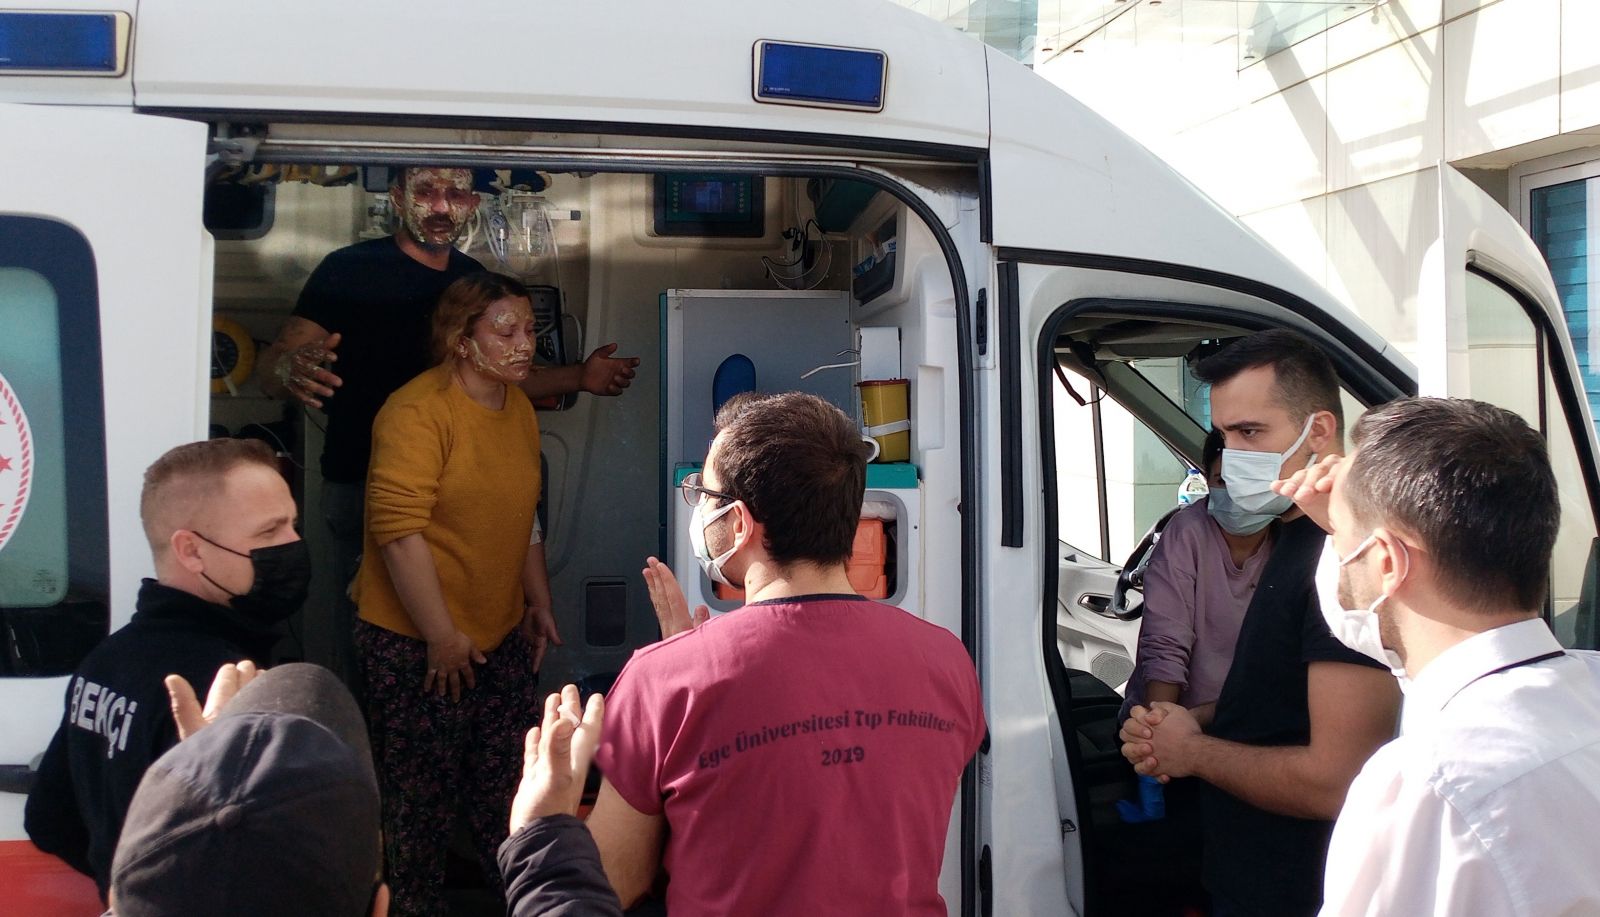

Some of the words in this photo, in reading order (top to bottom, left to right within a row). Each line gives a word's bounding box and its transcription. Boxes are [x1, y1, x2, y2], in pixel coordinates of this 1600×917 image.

[699, 744, 731, 769] Ege
[735, 710, 849, 752] Üniversitesi
[855, 709, 882, 730] Tıp
[887, 709, 957, 733] Fakültesi
[820, 745, 865, 766] 2019
